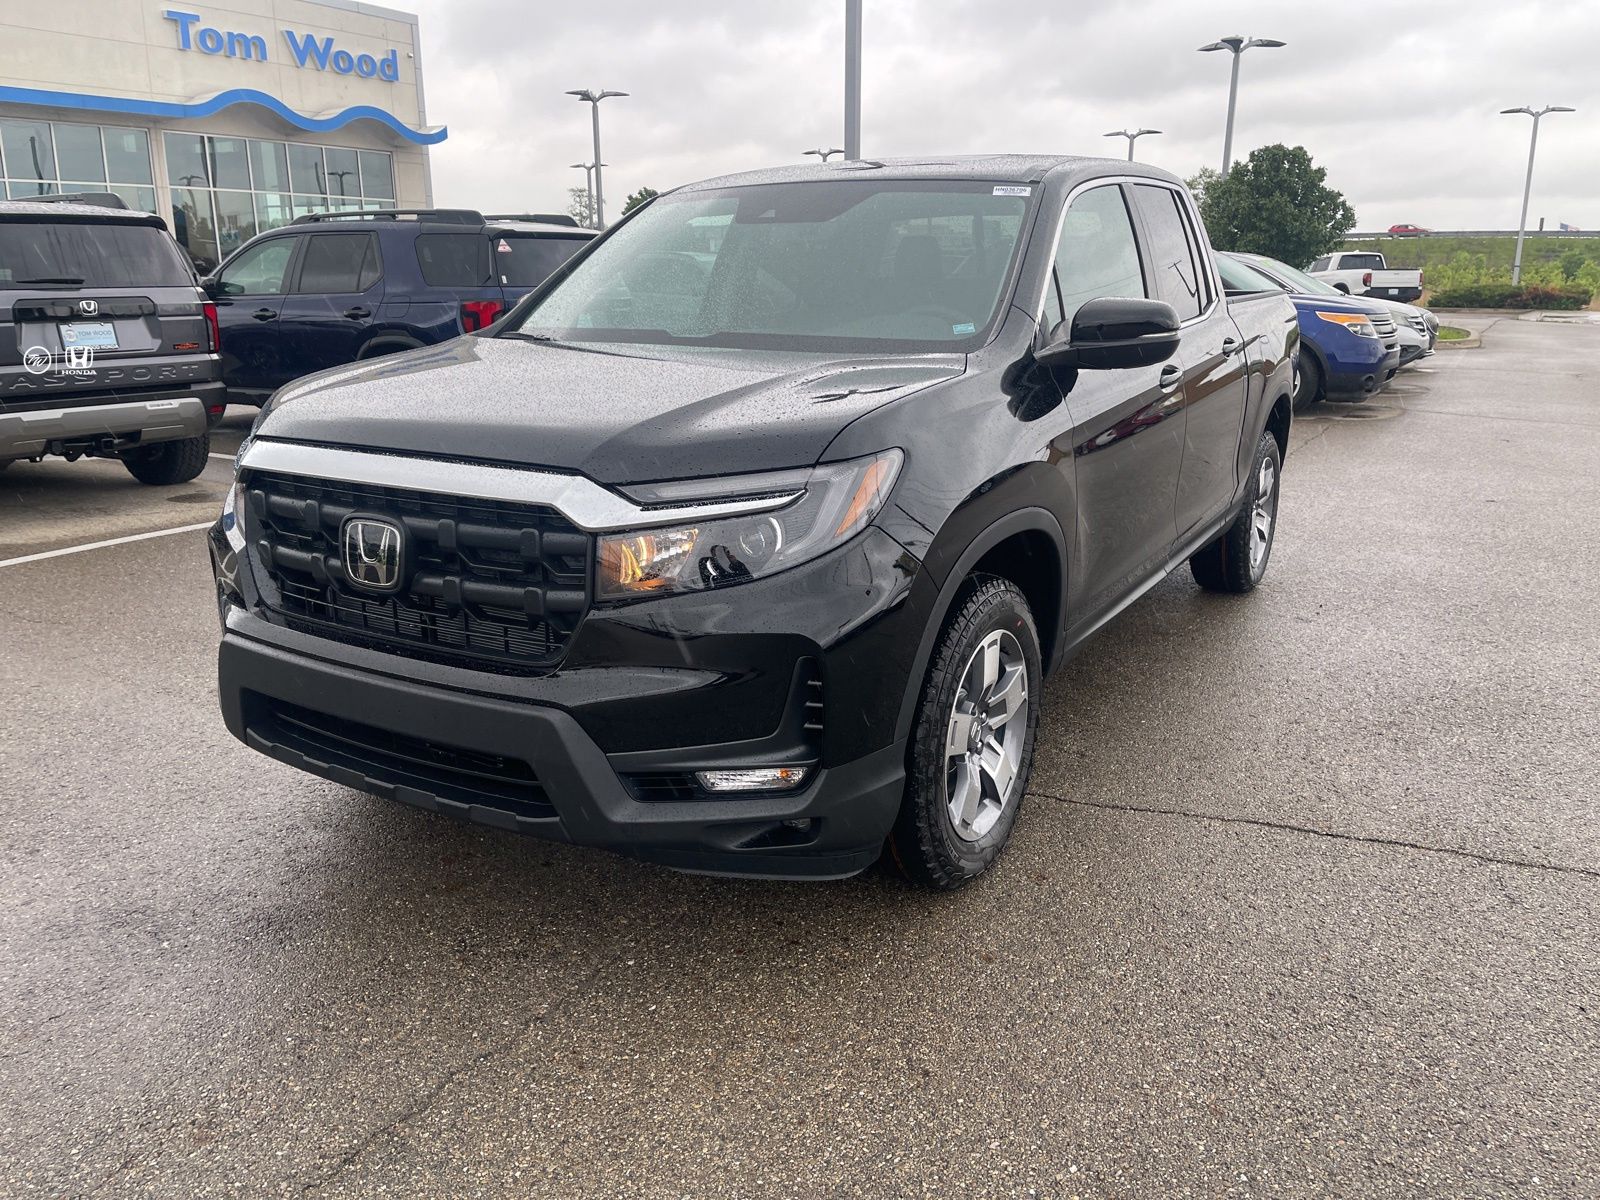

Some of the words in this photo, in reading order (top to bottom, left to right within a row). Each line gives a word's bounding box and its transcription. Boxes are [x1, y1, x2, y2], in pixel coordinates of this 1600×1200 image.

[163, 9, 268, 62] Tom
[280, 29, 400, 82] Wood
[0, 364, 200, 390] ASSPORT
